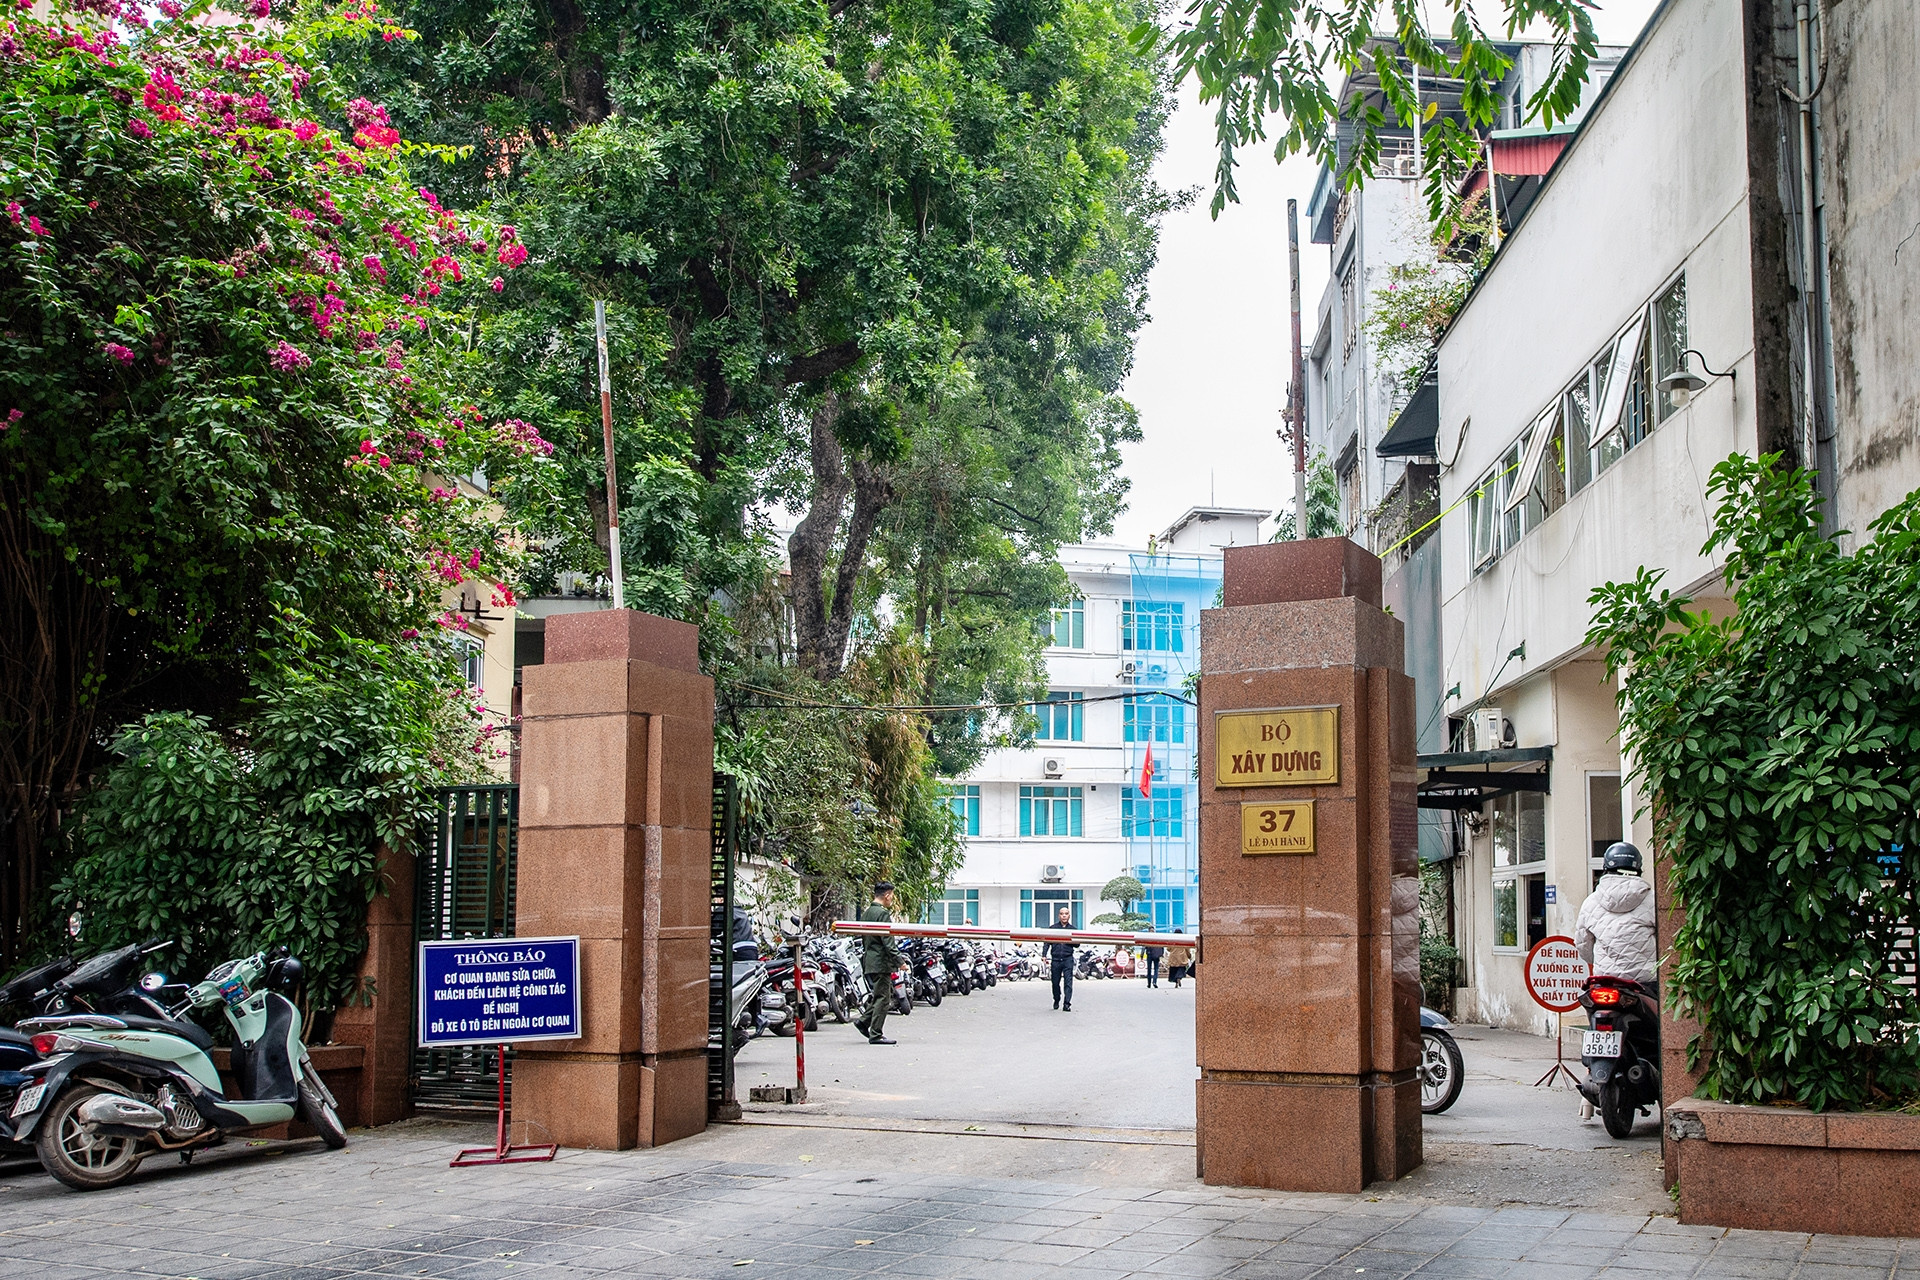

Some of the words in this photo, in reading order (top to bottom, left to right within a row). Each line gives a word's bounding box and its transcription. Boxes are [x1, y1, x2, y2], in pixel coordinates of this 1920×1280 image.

[1261, 719, 1291, 745] BỘ
[1231, 750, 1266, 774] XÂY
[1272, 750, 1321, 776] DỰNG
[1259, 809, 1296, 833] 37
[1262, 837, 1278, 848] ĐẠI
[1280, 835, 1306, 846] HÀNH
[454, 950, 509, 964] THÔNG
[513, 948, 546, 962] BÁO
[1556, 949, 1578, 960] NGHỊ
[1536, 962, 1569, 973] XUỐNG
[1572, 965, 1584, 974] XE
[444, 972, 457, 984] CƠ
[459, 972, 483, 984] QUAN
[485, 970, 510, 983] ĐANG
[512, 967, 530, 981] SỬA
[532, 967, 556, 980] CHỮA
[1533, 976, 1557, 988] XUẤT
[434, 988, 465, 1000] KHÁCH
[467, 985, 485, 999] ĐẾN
[488, 986, 507, 999] LIÊN
[509, 985, 520, 999] HỆ
[523, 984, 547, 997] CÔNG
[549, 983, 566, 995] TÁC
[1542, 990, 1564, 1001] GIẤY
[497, 1002, 519, 1015] NGHỊ
[446, 1021, 458, 1032] XE
[460, 1019, 467, 1030] Ô
[469, 1019, 480, 1031] TÔ
[482, 1018, 500, 1030] BÊN
[502, 1016, 530, 1030] NGOÀI
[532, 1015, 544, 1028] CƠ
[546, 1015, 570, 1027] QUAN
[1592, 1033, 1616, 1044] 19-P1
